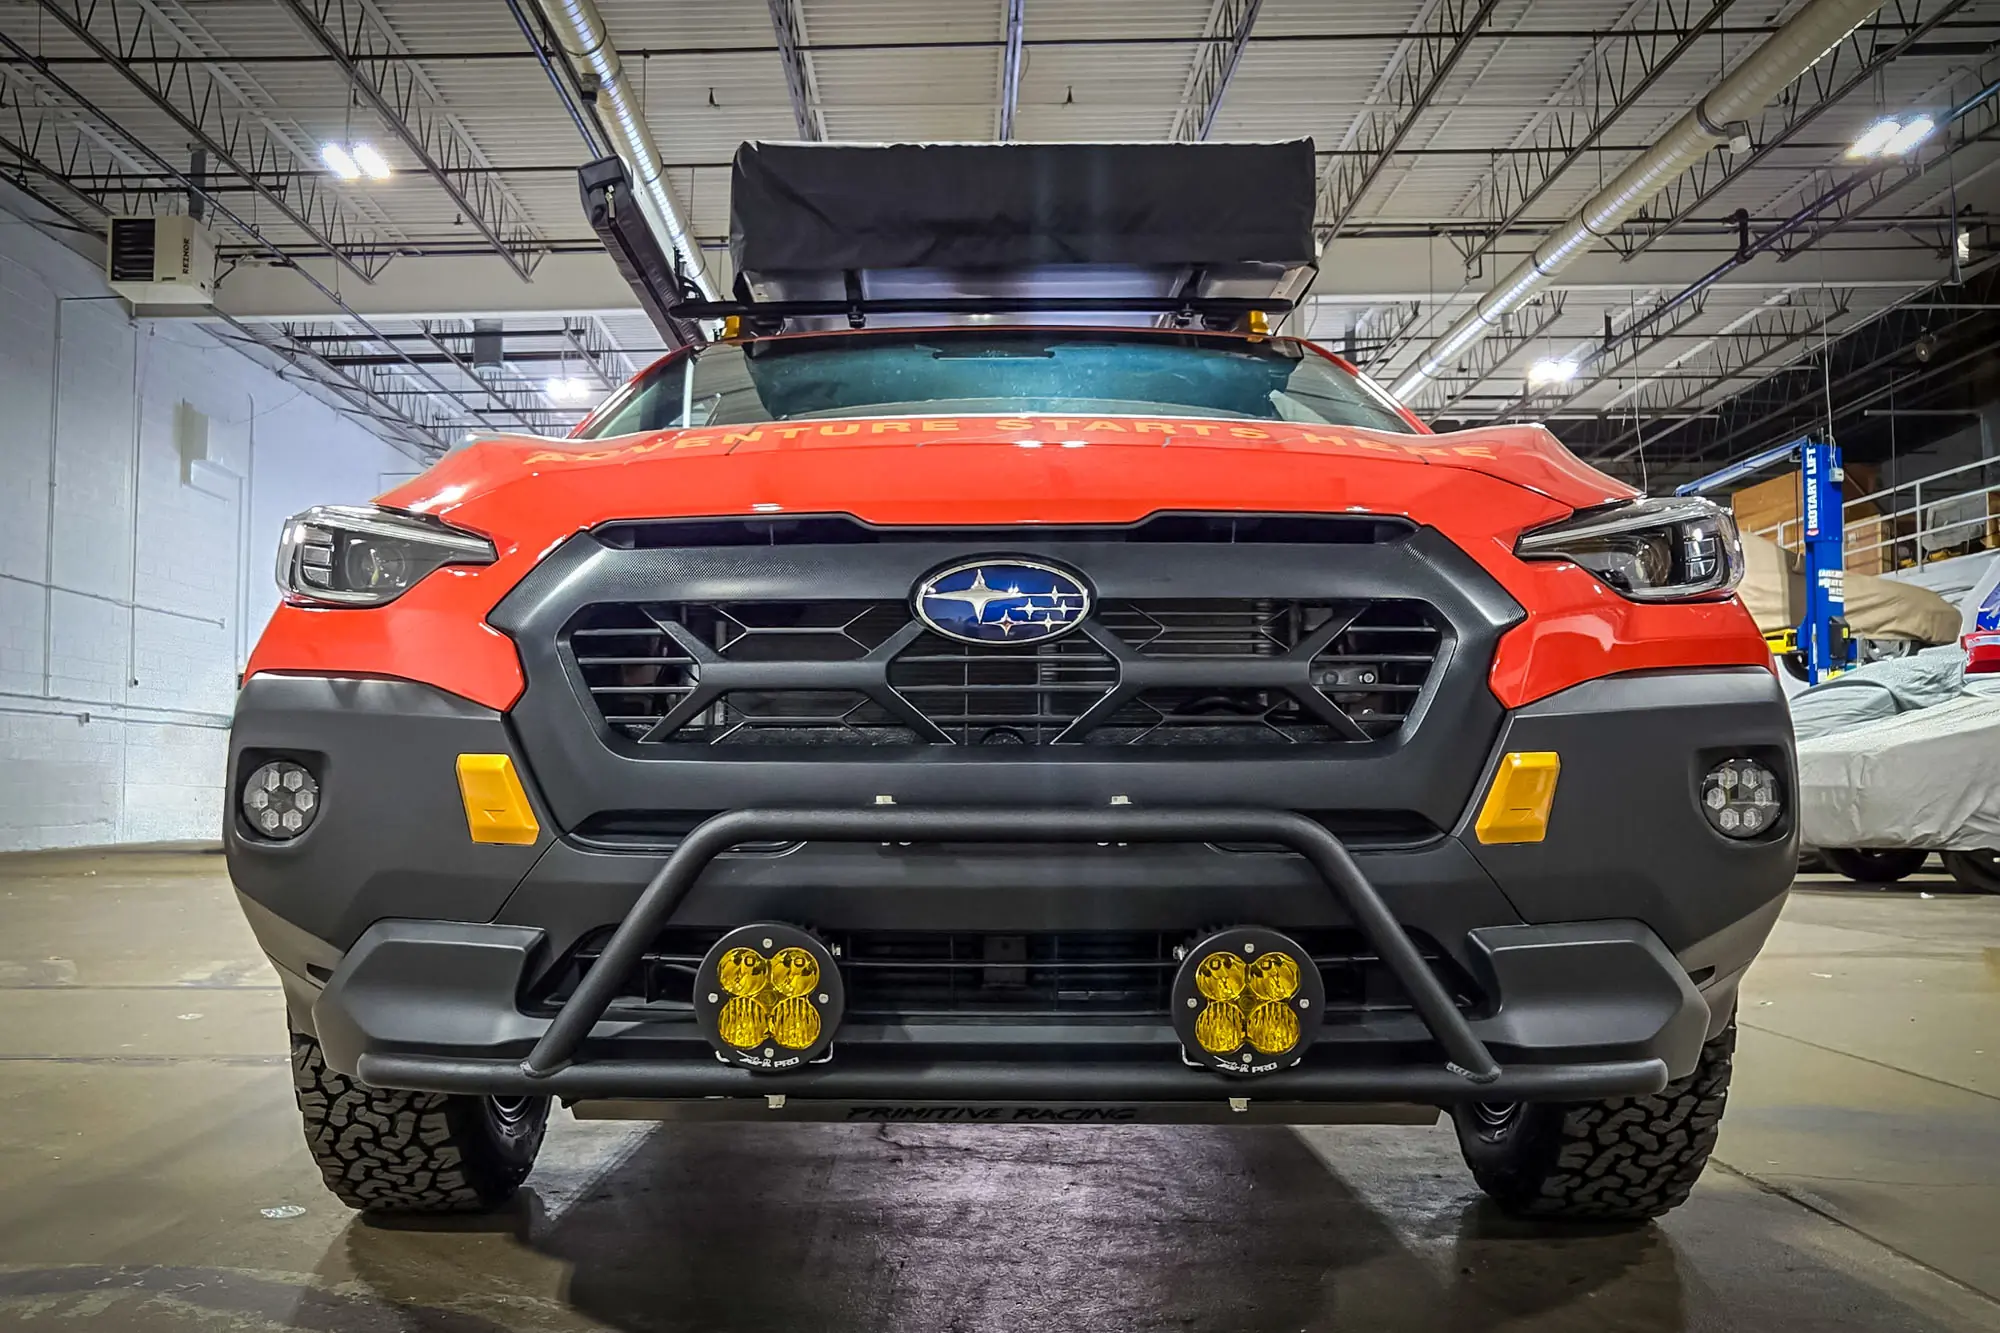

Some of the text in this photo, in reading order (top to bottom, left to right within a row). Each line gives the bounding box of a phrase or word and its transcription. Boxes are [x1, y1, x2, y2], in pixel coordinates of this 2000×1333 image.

[182, 238, 190, 274] REZNOR
[523, 419, 1498, 465] ADVENTURE STARTS HERE
[1806, 447, 1818, 529] ROTARY LIFT
[773, 1056, 800, 1068] PRO
[1251, 1061, 1278, 1073] PRO
[847, 1106, 1138, 1121] PRIMITIVE RACING
